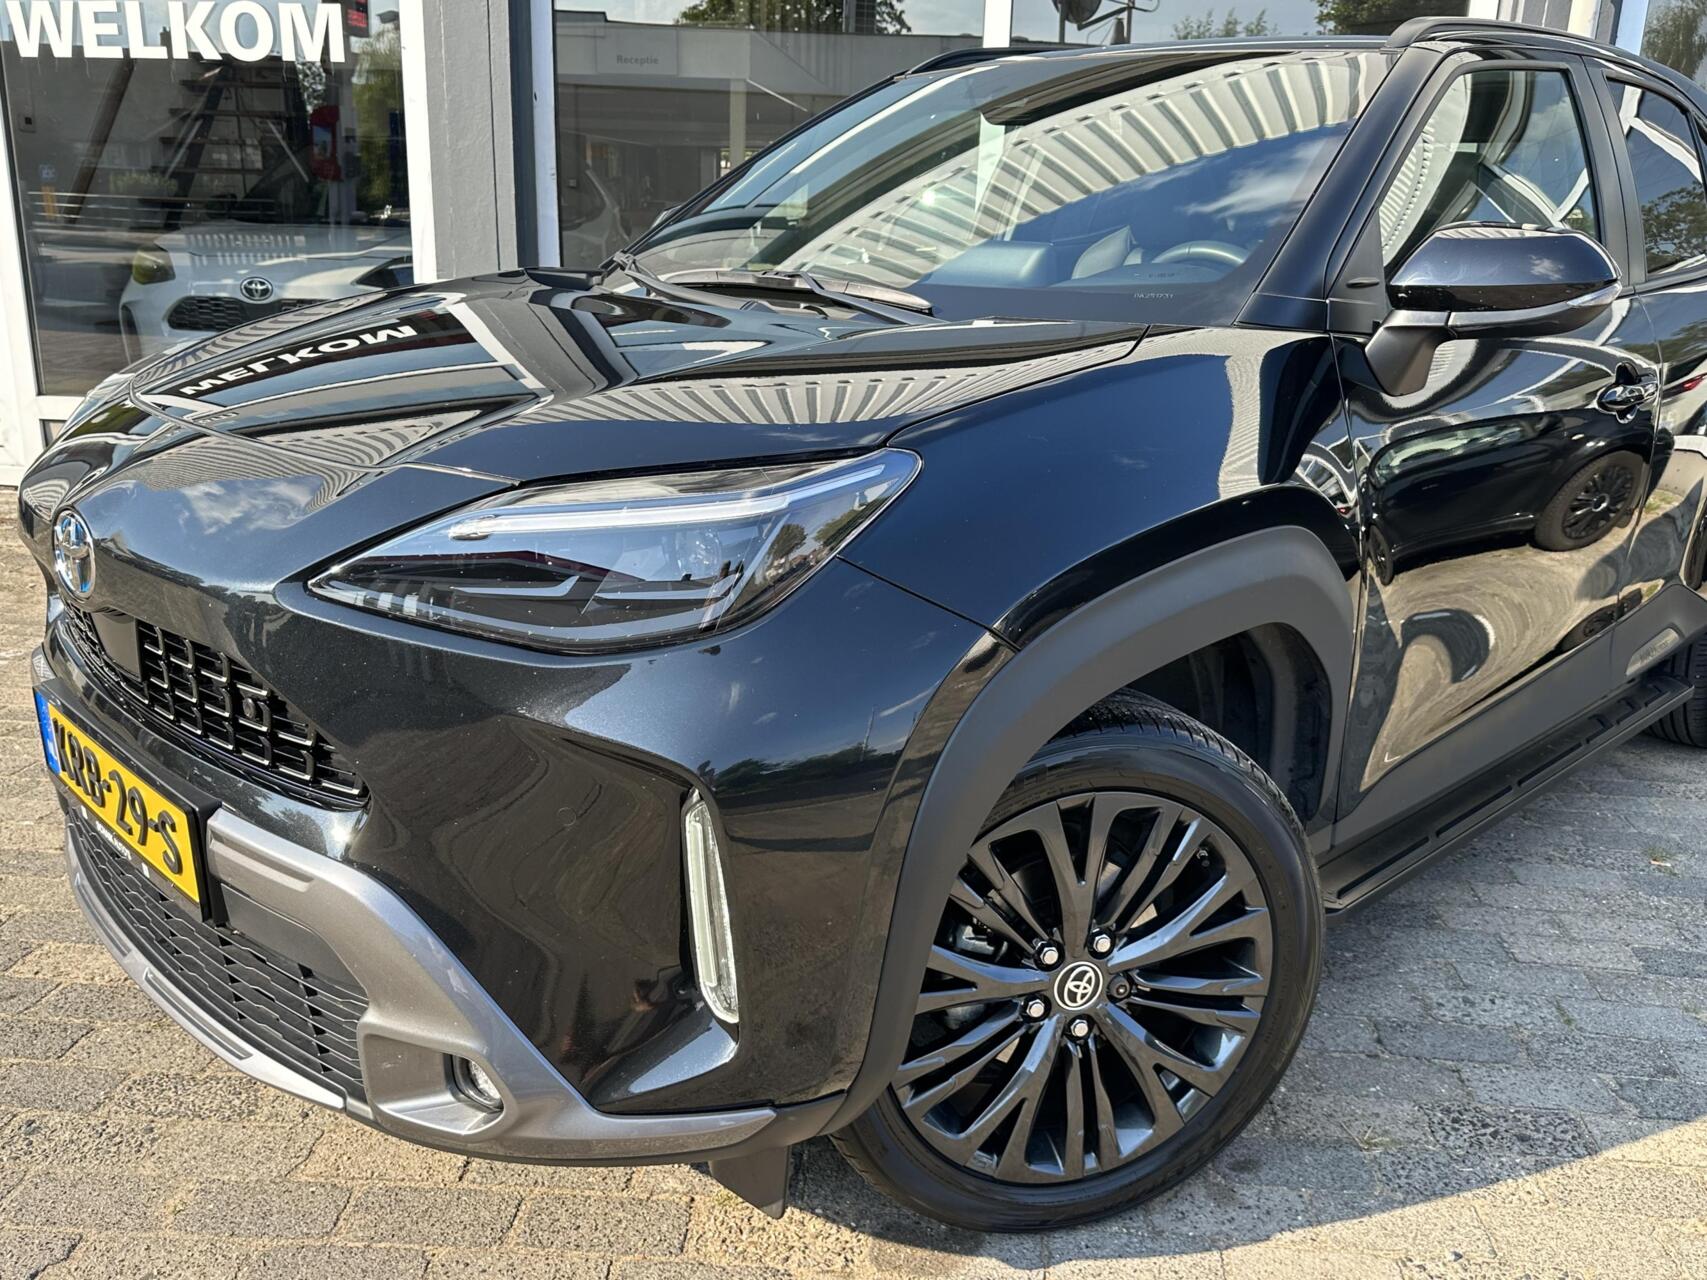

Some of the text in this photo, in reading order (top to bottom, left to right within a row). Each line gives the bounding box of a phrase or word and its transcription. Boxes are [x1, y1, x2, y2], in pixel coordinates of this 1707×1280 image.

[6, 0, 346, 63] WELKOM
[616, 54, 660, 66] Receptie
[52, 717, 183, 875] KRB-29-S
